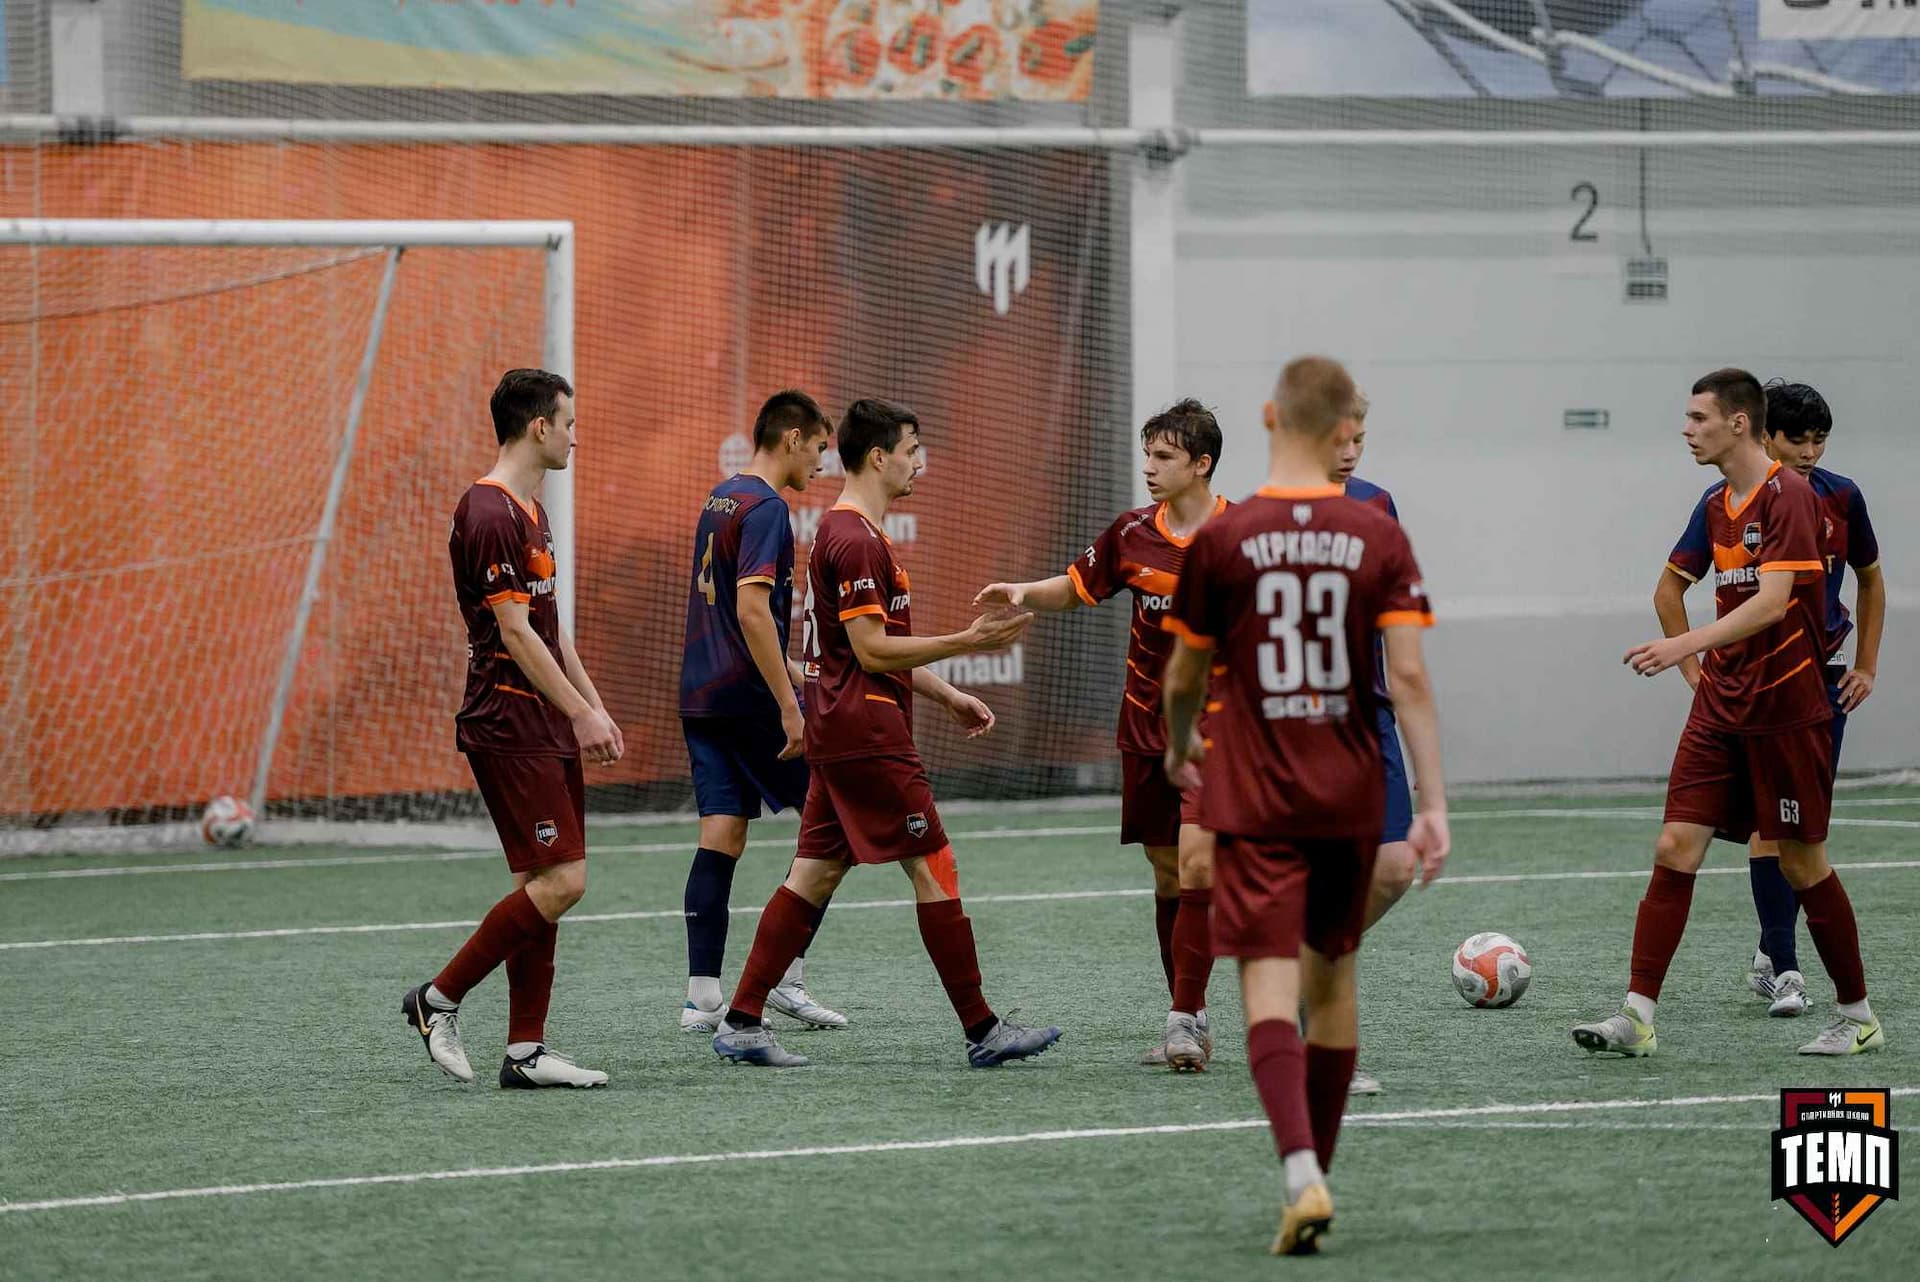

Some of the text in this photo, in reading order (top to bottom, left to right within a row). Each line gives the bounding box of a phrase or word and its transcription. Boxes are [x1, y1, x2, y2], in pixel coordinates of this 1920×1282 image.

[1570, 181, 1598, 242] 2
[697, 532, 716, 605] 4
[1241, 531, 1365, 570] ЧЕРКАСОВ
[853, 578, 876, 593] ПСБ
[1256, 571, 1351, 693] 33
[1780, 798, 1800, 824] 63
